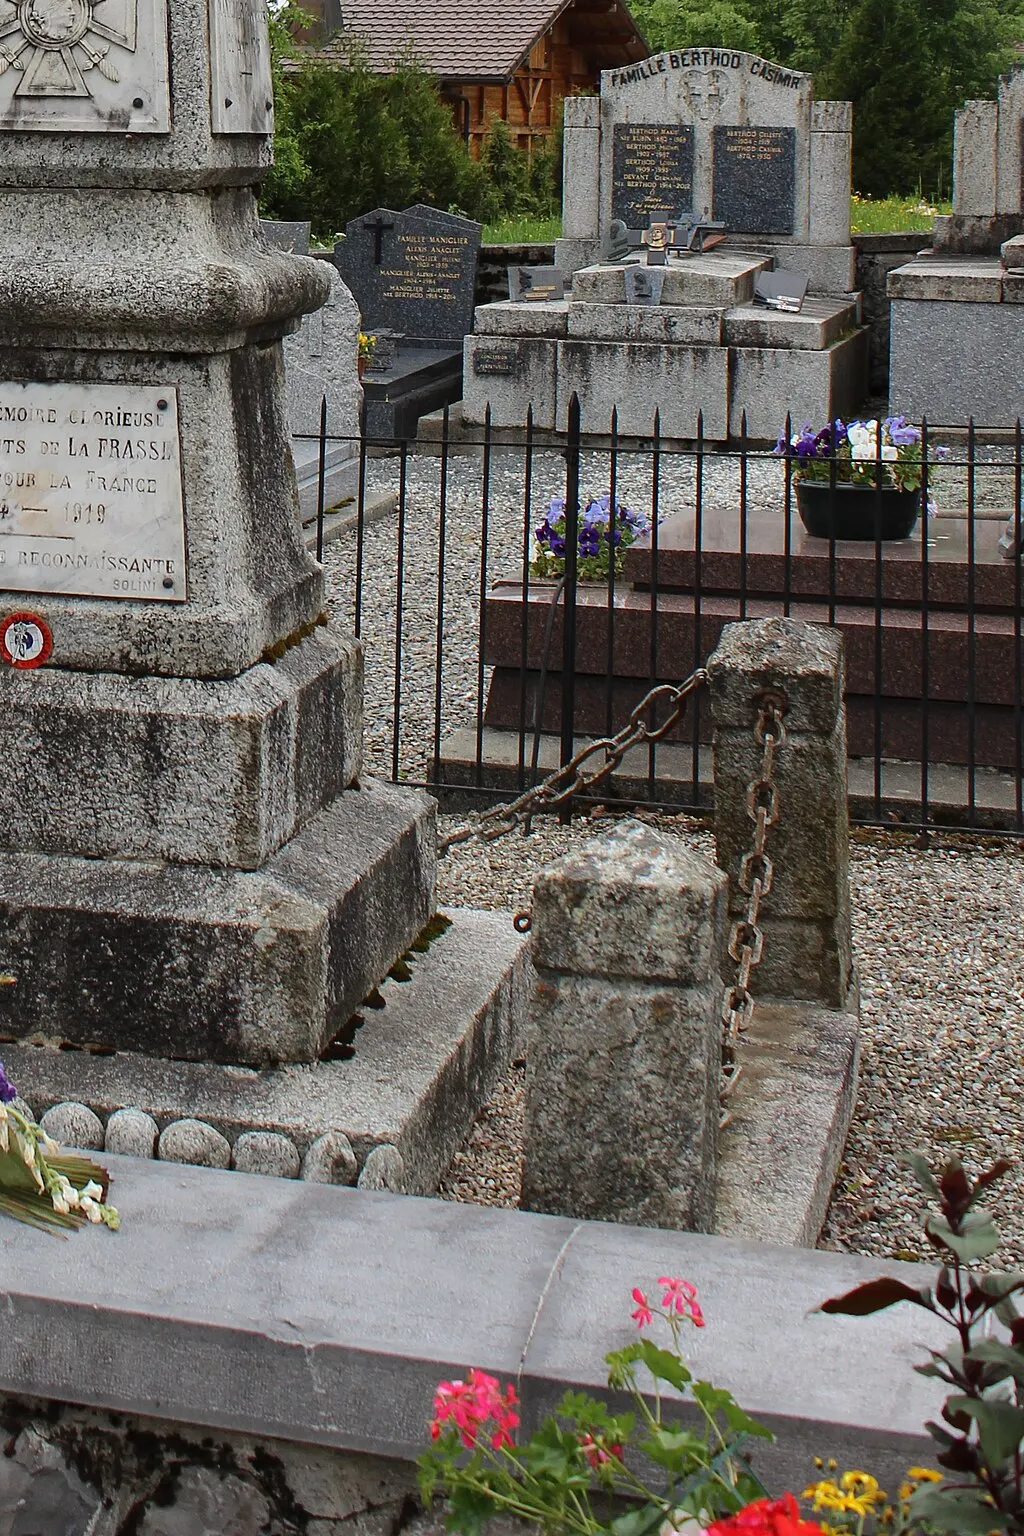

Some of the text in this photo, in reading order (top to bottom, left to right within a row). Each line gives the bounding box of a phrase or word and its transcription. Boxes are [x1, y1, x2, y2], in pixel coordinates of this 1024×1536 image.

[611, 51, 802, 89] FAMILLE BERTHOD CASIMIR
[429, 236, 469, 244] MANIGLIER
[40, 441, 60, 455] DE
[69, 437, 89, 457] LA
[98, 438, 173, 461] FRASSE
[50, 473, 72, 489] LA
[87, 470, 157, 494] FRANCE
[65, 502, 106, 525] 1919
[18, 550, 175, 574] RECONNAISSANTE
